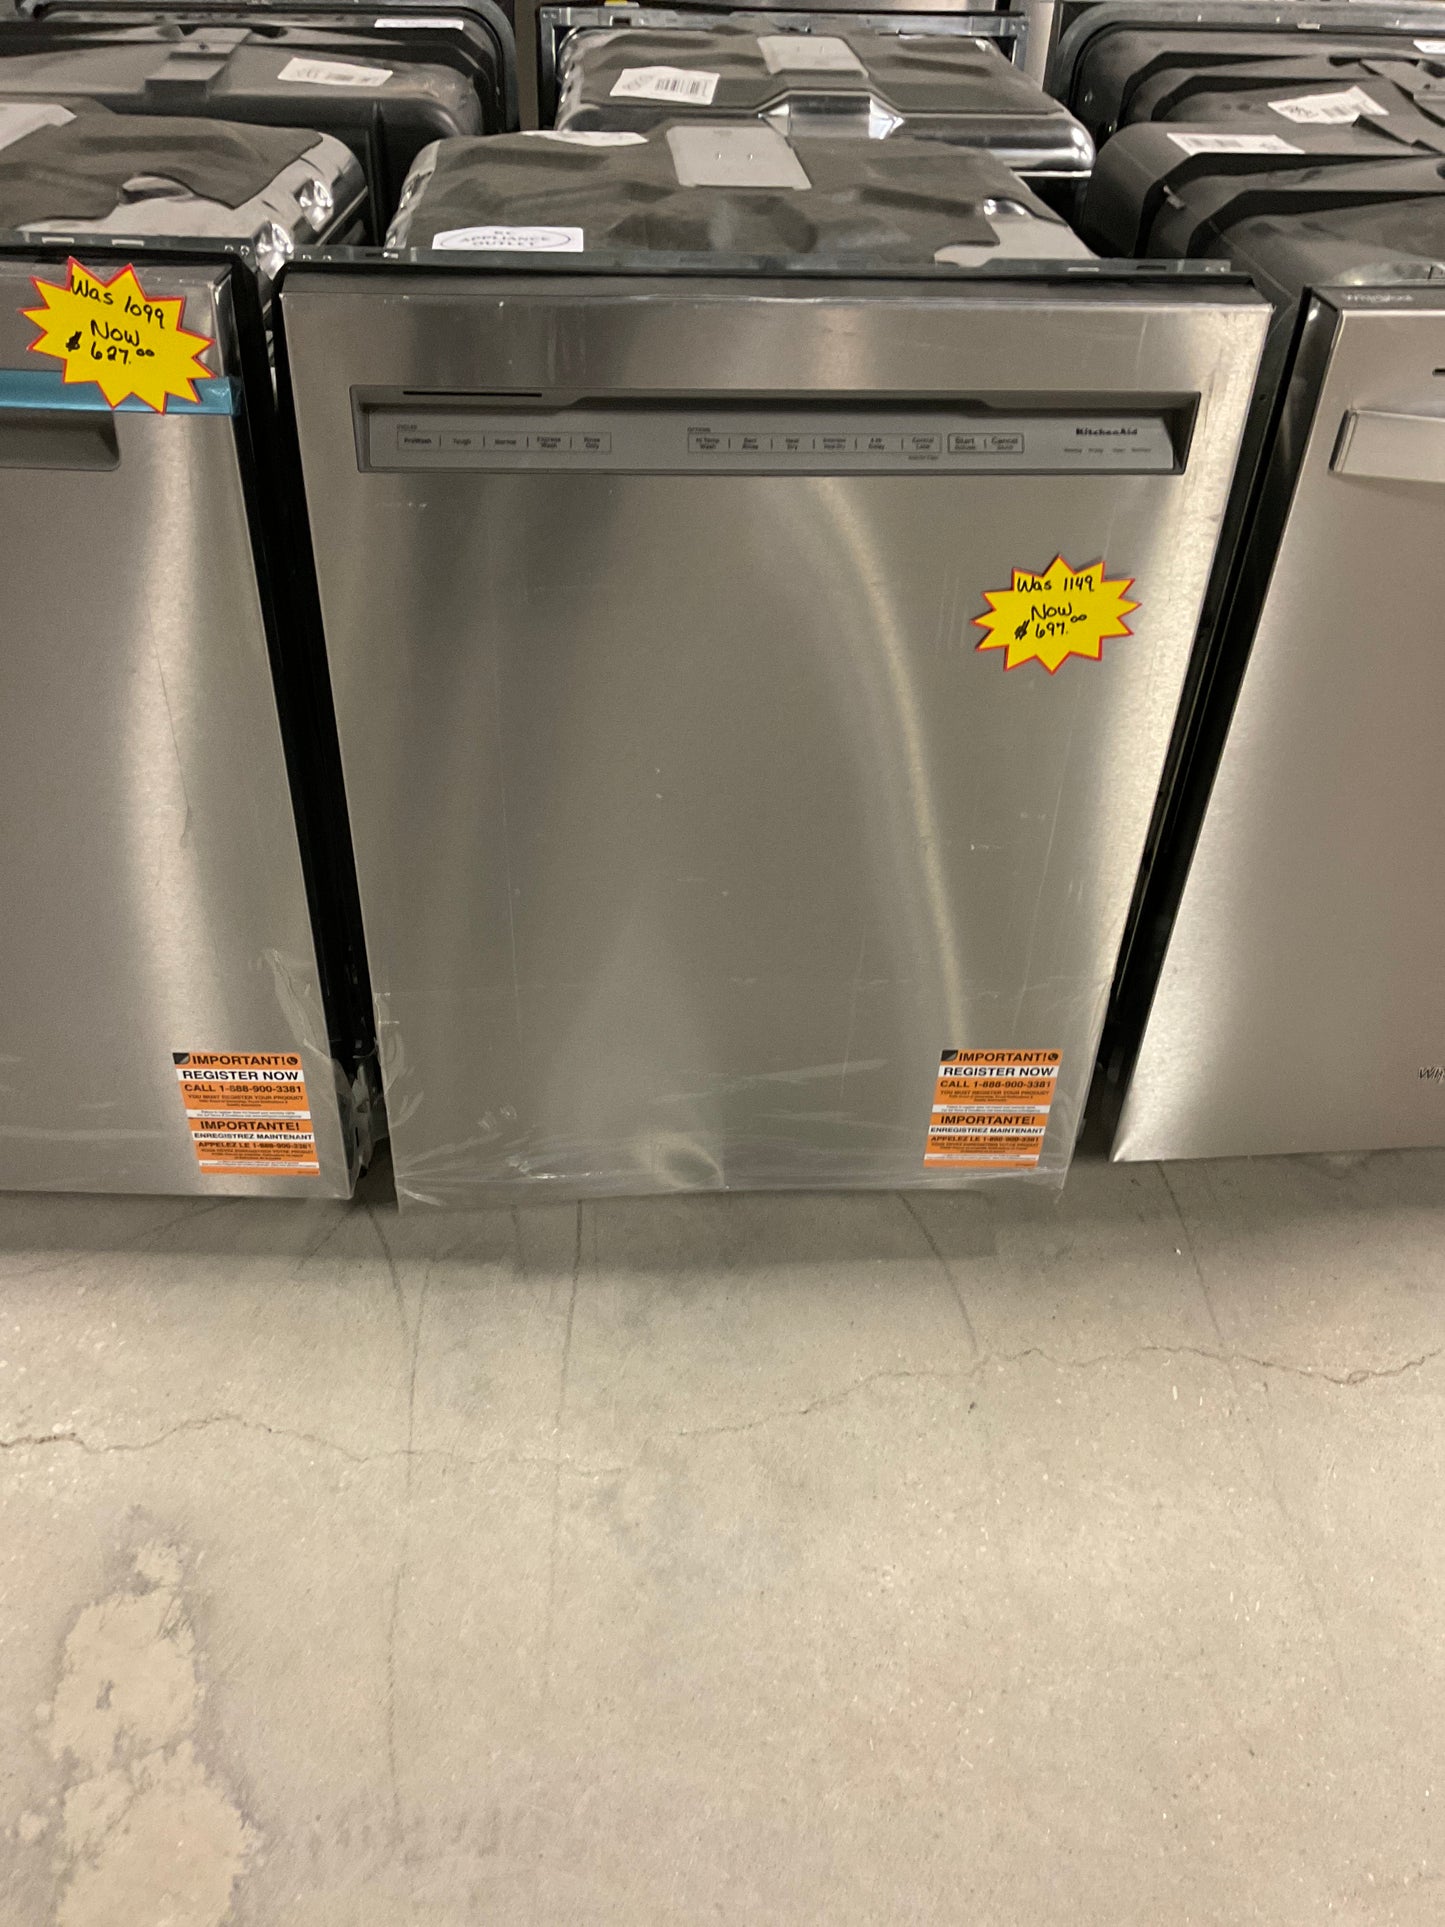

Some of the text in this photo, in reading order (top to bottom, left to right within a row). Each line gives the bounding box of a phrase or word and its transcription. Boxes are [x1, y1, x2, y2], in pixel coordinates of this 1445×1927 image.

[71, 275, 165, 329] Was 1099
[1076, 427, 1138, 435] KitchenAid
[1017, 575, 1052, 593] Was
[192, 1055, 286, 1066] IMPORTANT!
[958, 1052, 1047, 1062] IMPORTANT!
[182, 1070, 299, 1081] REGISTER NOW
[943, 1067, 1055, 1077] REGISTER NOW
[184, 1084, 302, 1093] CALL 1-888-900-3381
[940, 1080, 1051, 1088] CALL 1-888-900-3381
[941, 1115, 1036, 1125] IMPORTANTE!
[200, 1121, 300, 1131] IMPORTANTE!
[194, 1132, 255, 1140] ENREGISTREZ
[198, 1141, 237, 1149] APPELEZ
